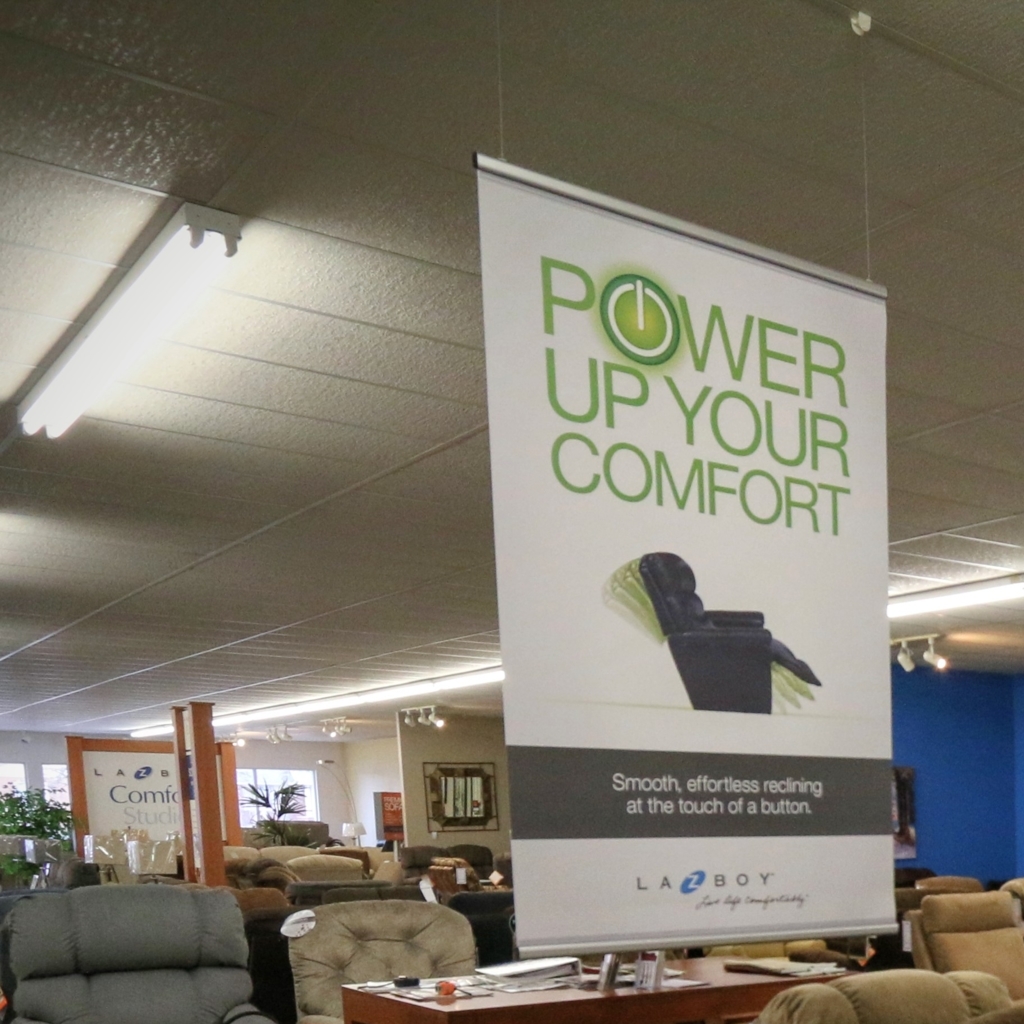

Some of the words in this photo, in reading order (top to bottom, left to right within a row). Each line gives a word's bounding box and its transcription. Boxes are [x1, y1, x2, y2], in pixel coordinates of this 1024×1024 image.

[541, 255, 848, 408] POWER
[545, 347, 650, 429] UP
[663, 375, 850, 477] YOUR
[550, 432, 851, 537] COMFORT
[124, 806, 182, 825] Studi
[612, 772, 682, 793] Smooth,
[686, 774, 760, 793] effortless
[763, 777, 823, 798] reclining
[626, 798, 644, 814] at
[647, 797, 674, 814] the
[678, 798, 724, 814] touch
[727, 798, 744, 814] of
[746, 801, 757, 814] a
[761, 798, 812, 814] button.
